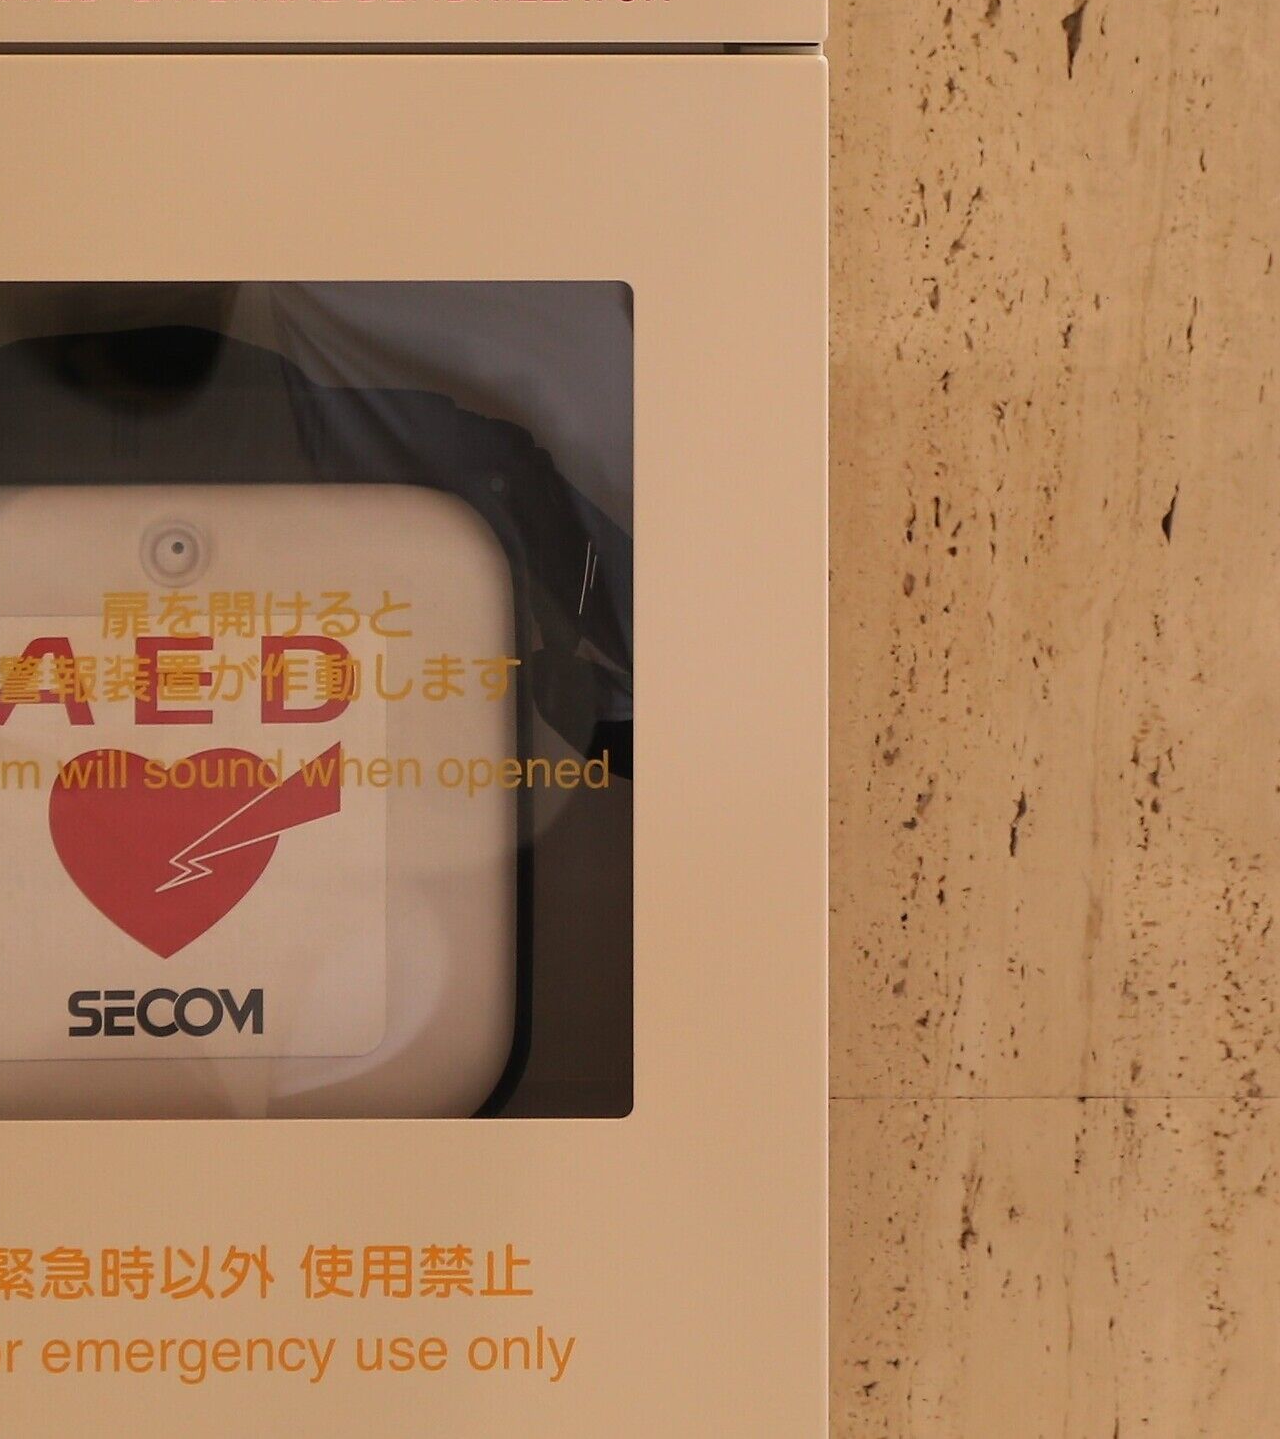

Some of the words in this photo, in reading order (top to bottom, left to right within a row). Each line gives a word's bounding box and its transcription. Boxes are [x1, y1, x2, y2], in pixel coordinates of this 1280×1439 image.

[100, 591, 414, 639] 扉を開けると
[57, 751, 128, 789] will
[142, 750, 286, 789] sound
[300, 749, 422, 790] when
[436, 749, 610, 799] opened
[67, 987, 264, 1038] SECOM
[299, 1244, 534, 1299] 使用禁止
[40, 1336, 336, 1385] emergency
[356, 1335, 448, 1372] use
[467, 1326, 576, 1383] only
